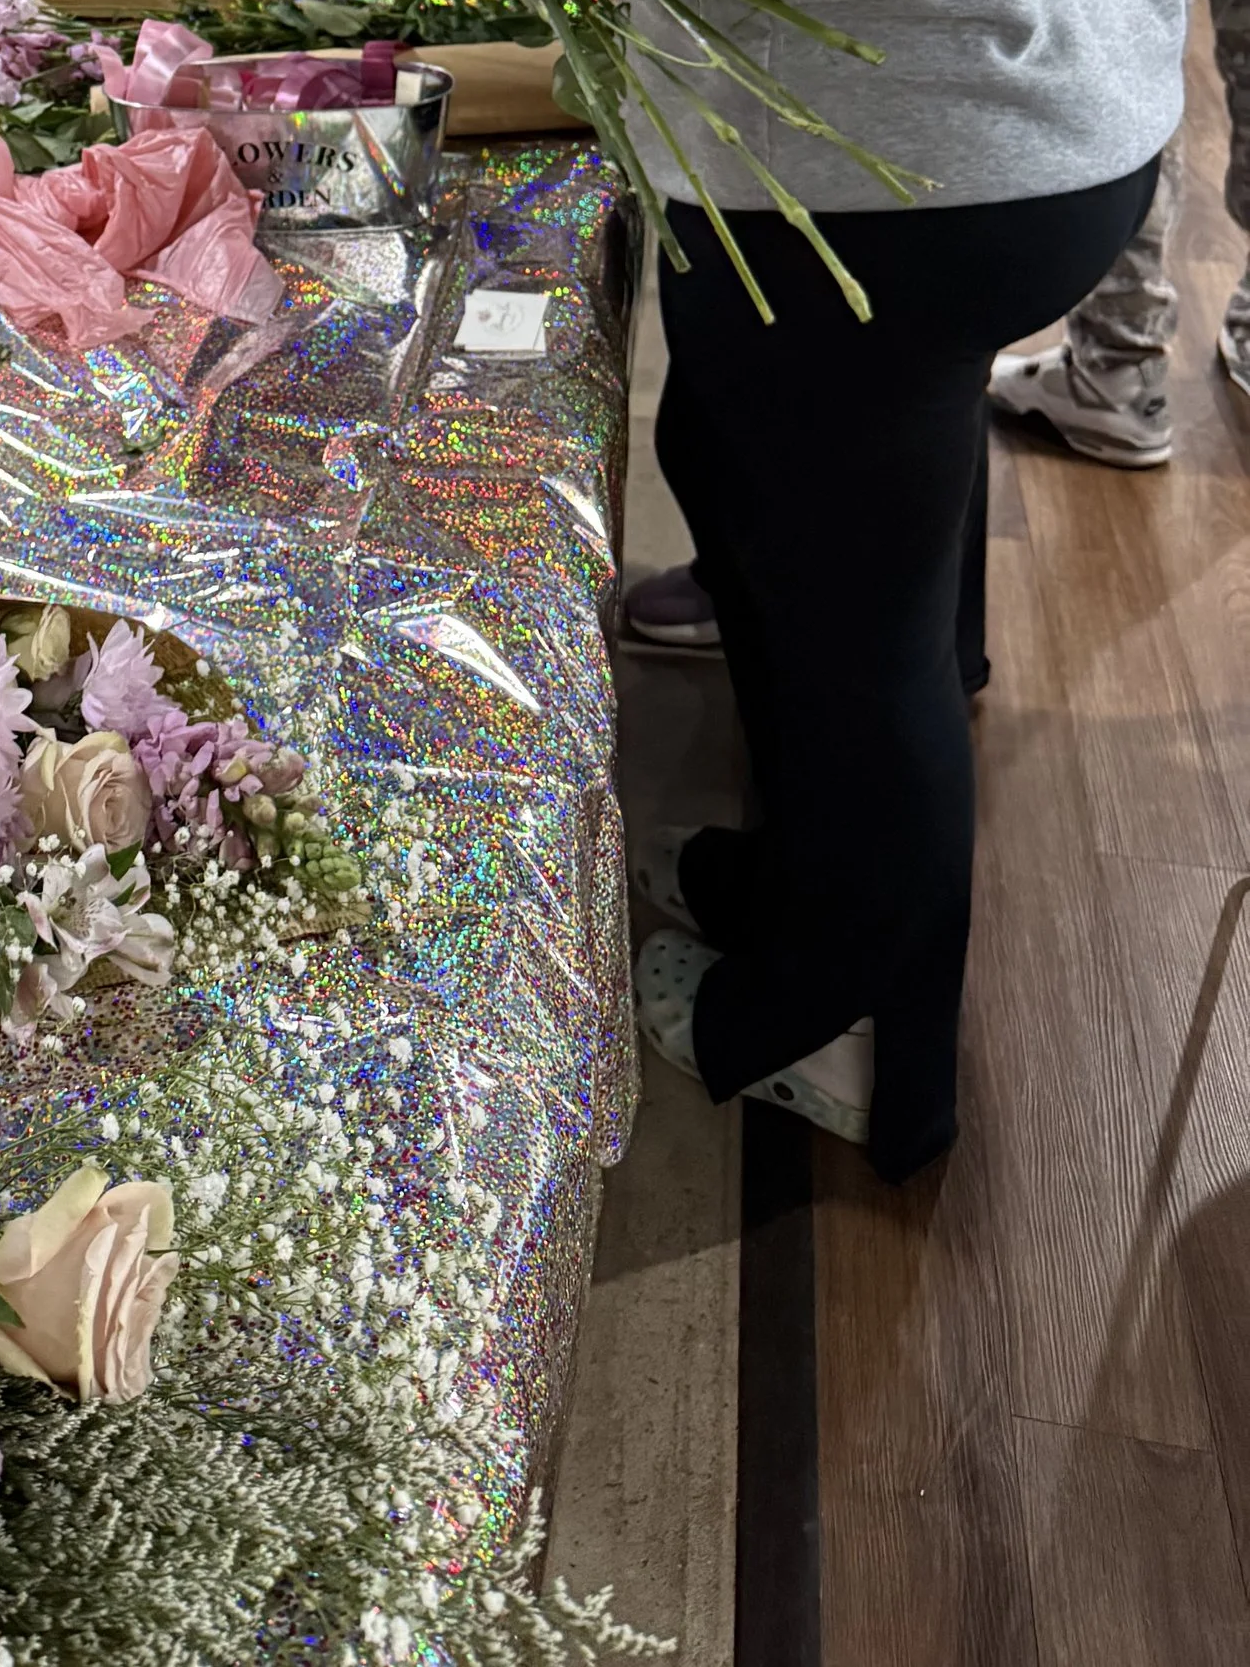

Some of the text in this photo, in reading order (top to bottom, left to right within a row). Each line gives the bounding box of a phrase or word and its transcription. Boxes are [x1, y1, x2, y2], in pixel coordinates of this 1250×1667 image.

[232, 141, 357, 172] OWERS
[267, 171, 284, 184] &
[262, 189, 331, 208] RDEN
